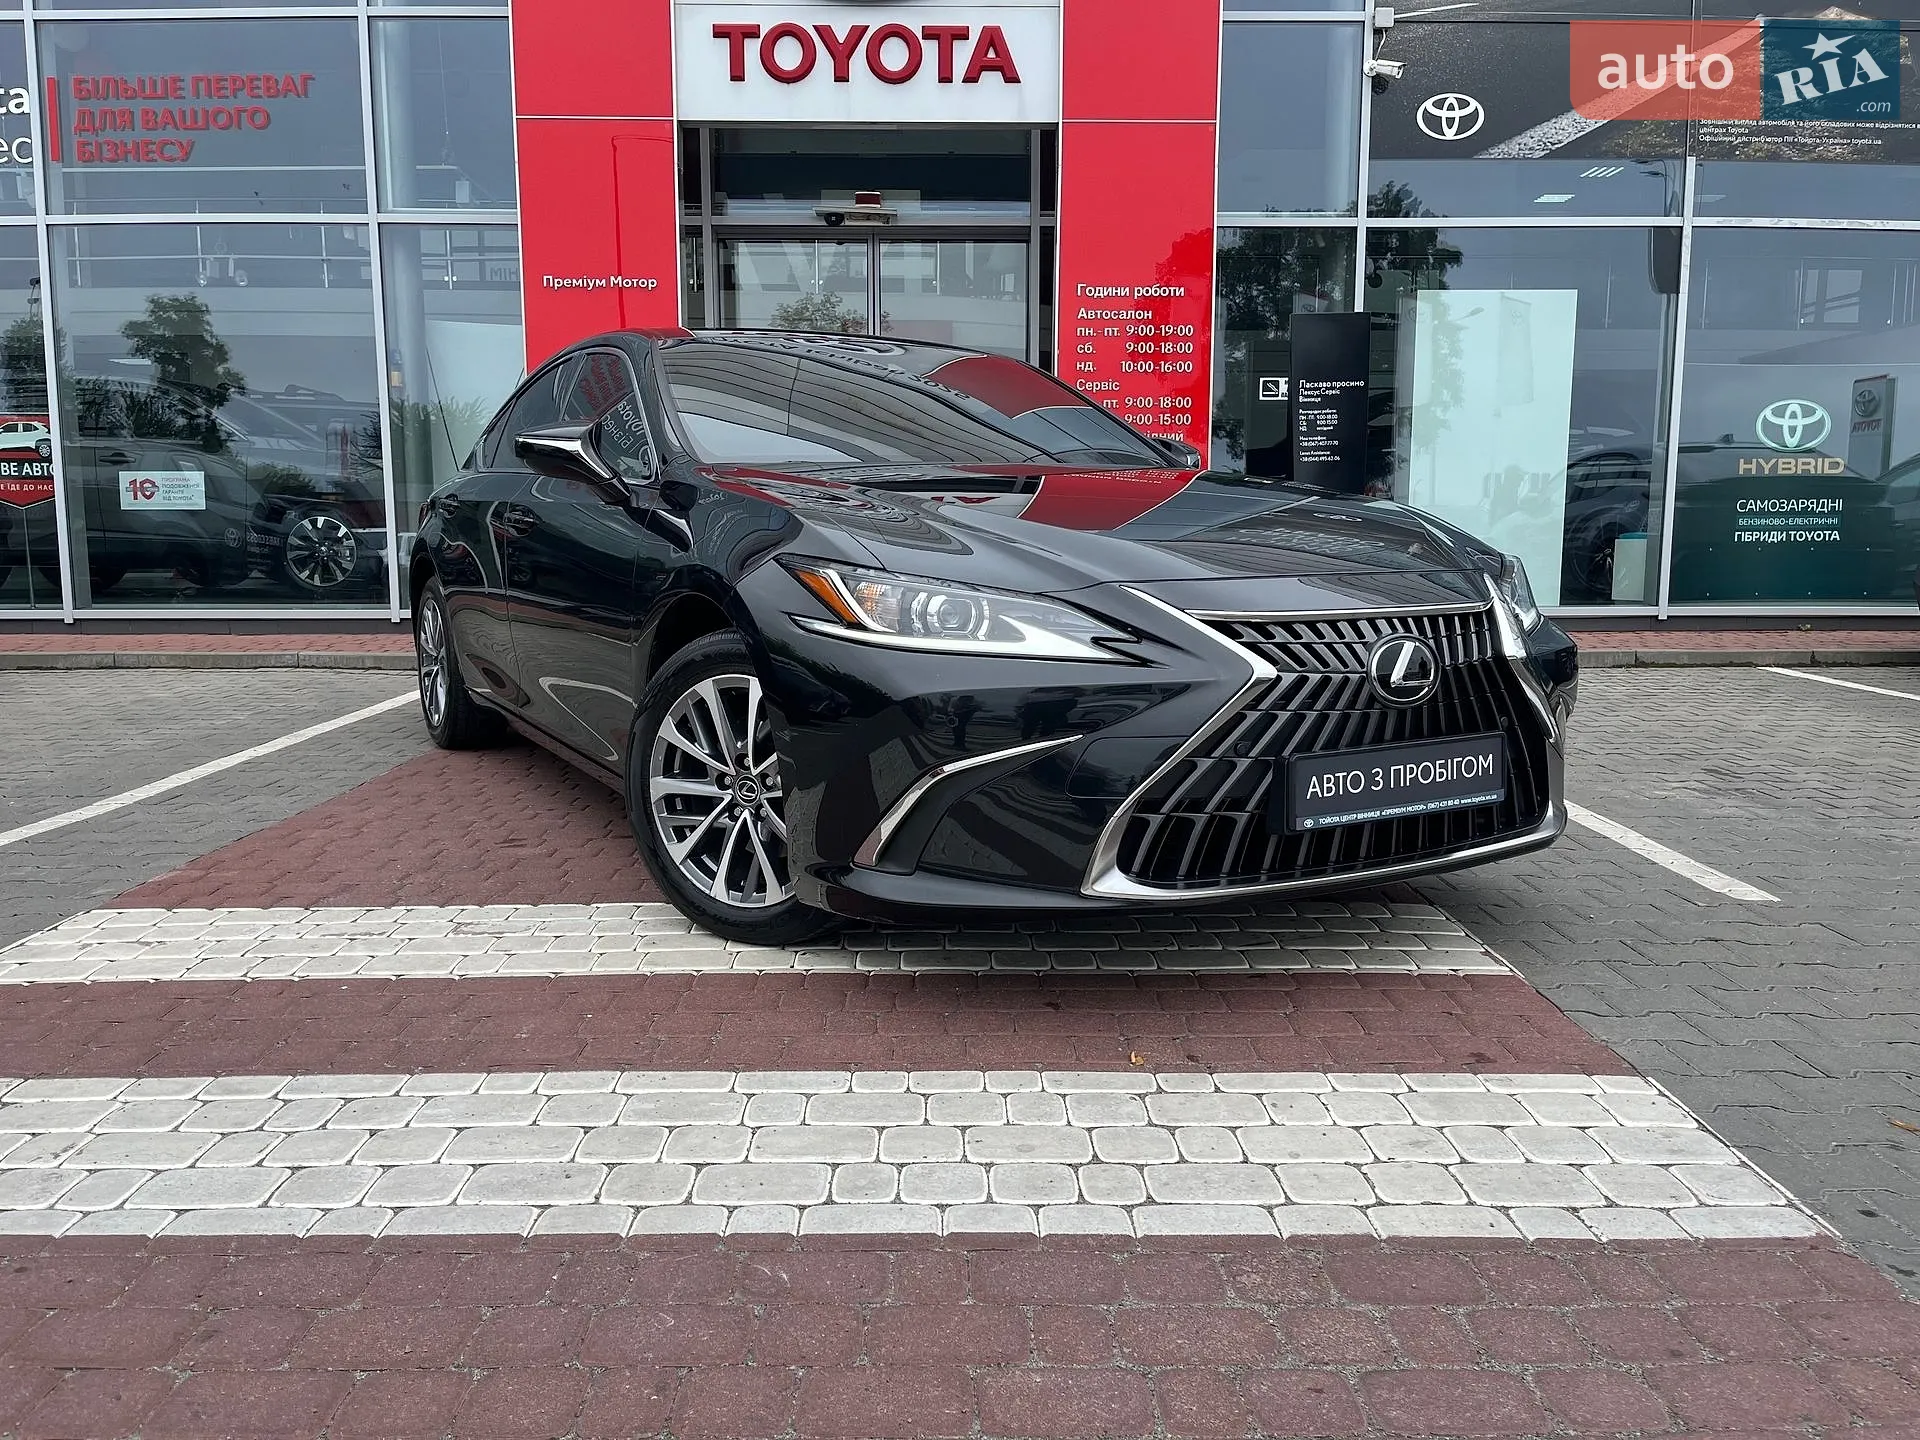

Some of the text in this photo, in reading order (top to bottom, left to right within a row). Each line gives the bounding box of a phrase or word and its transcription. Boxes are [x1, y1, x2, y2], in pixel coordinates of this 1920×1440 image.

[713, 22, 1021, 84] TOYOTA
[72, 74, 315, 100] БІЛЬШЕ ПЕРЕВАГ
[73, 105, 271, 135] ДЛЯ ВАШОГО
[76, 139, 195, 163] БІЗНЕСУ
[543, 276, 657, 290] Преміум Мотор
[1077, 284, 1185, 299] Години роботи
[1077, 308, 1152, 320] Автосалон
[1126, 325, 1194, 337] 9:00-19:00
[1077, 342, 1193, 354] сб. 9:00-18:00
[1076, 361, 1193, 373] нд. 10:00-16:00
[1076, 379, 1120, 392] Сервіс
[1125, 396, 1192, 409] 9:00-18:00
[1124, 413, 1192, 425] 9:00-15:00
[1738, 457, 1845, 475] HYBRID
[1736, 499, 1843, 513] САМОЗАРЯДНІ
[1738, 517, 1838, 526] БЕНЗИНОВО-ЕЛЕКТРИЧНІ
[1734, 530, 1840, 543] ГІБРИДИ TOYOTA
[1307, 770, 1364, 799] АВТО
[1391, 754, 1493, 788] ПРОБІГОМ
